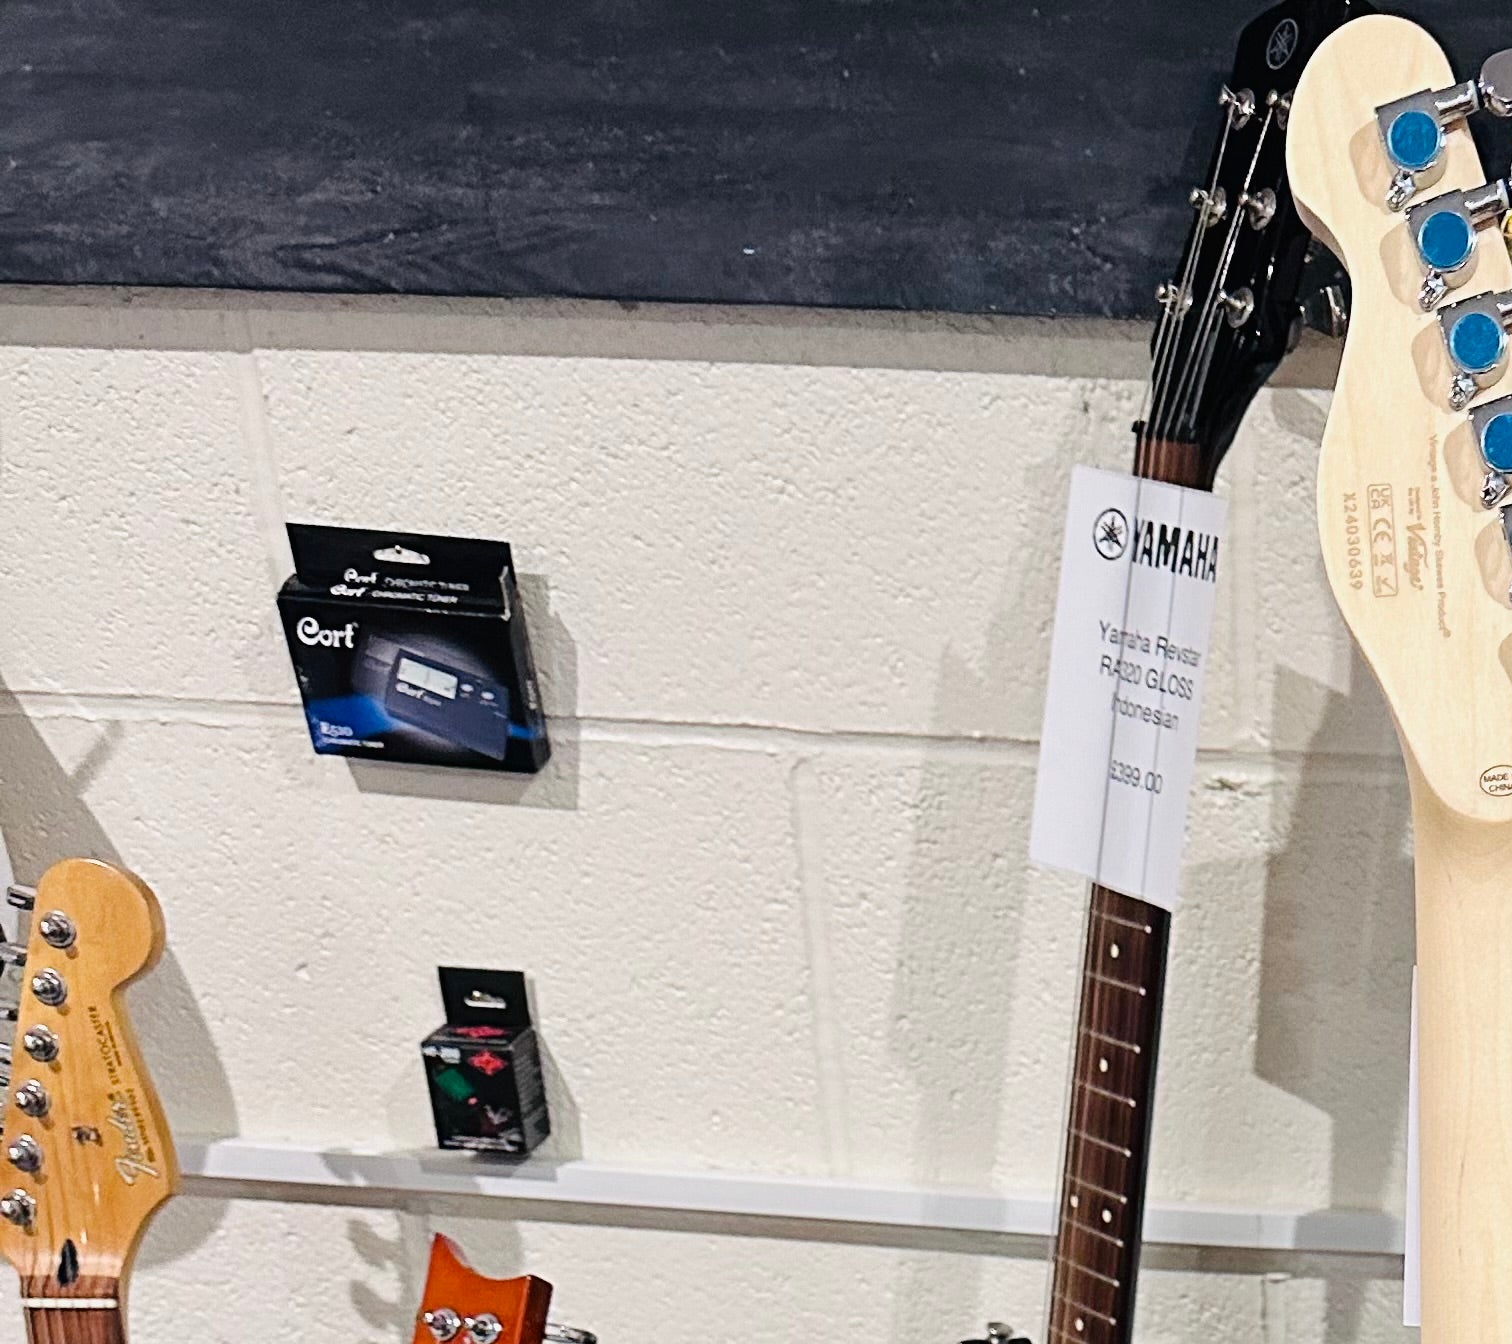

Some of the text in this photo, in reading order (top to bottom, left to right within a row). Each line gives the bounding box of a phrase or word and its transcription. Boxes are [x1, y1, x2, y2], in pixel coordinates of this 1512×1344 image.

[1131, 516, 1219, 583] YAMAHA
[296, 616, 356, 649] Cort
[1145, 668, 1194, 700] GLOSS
